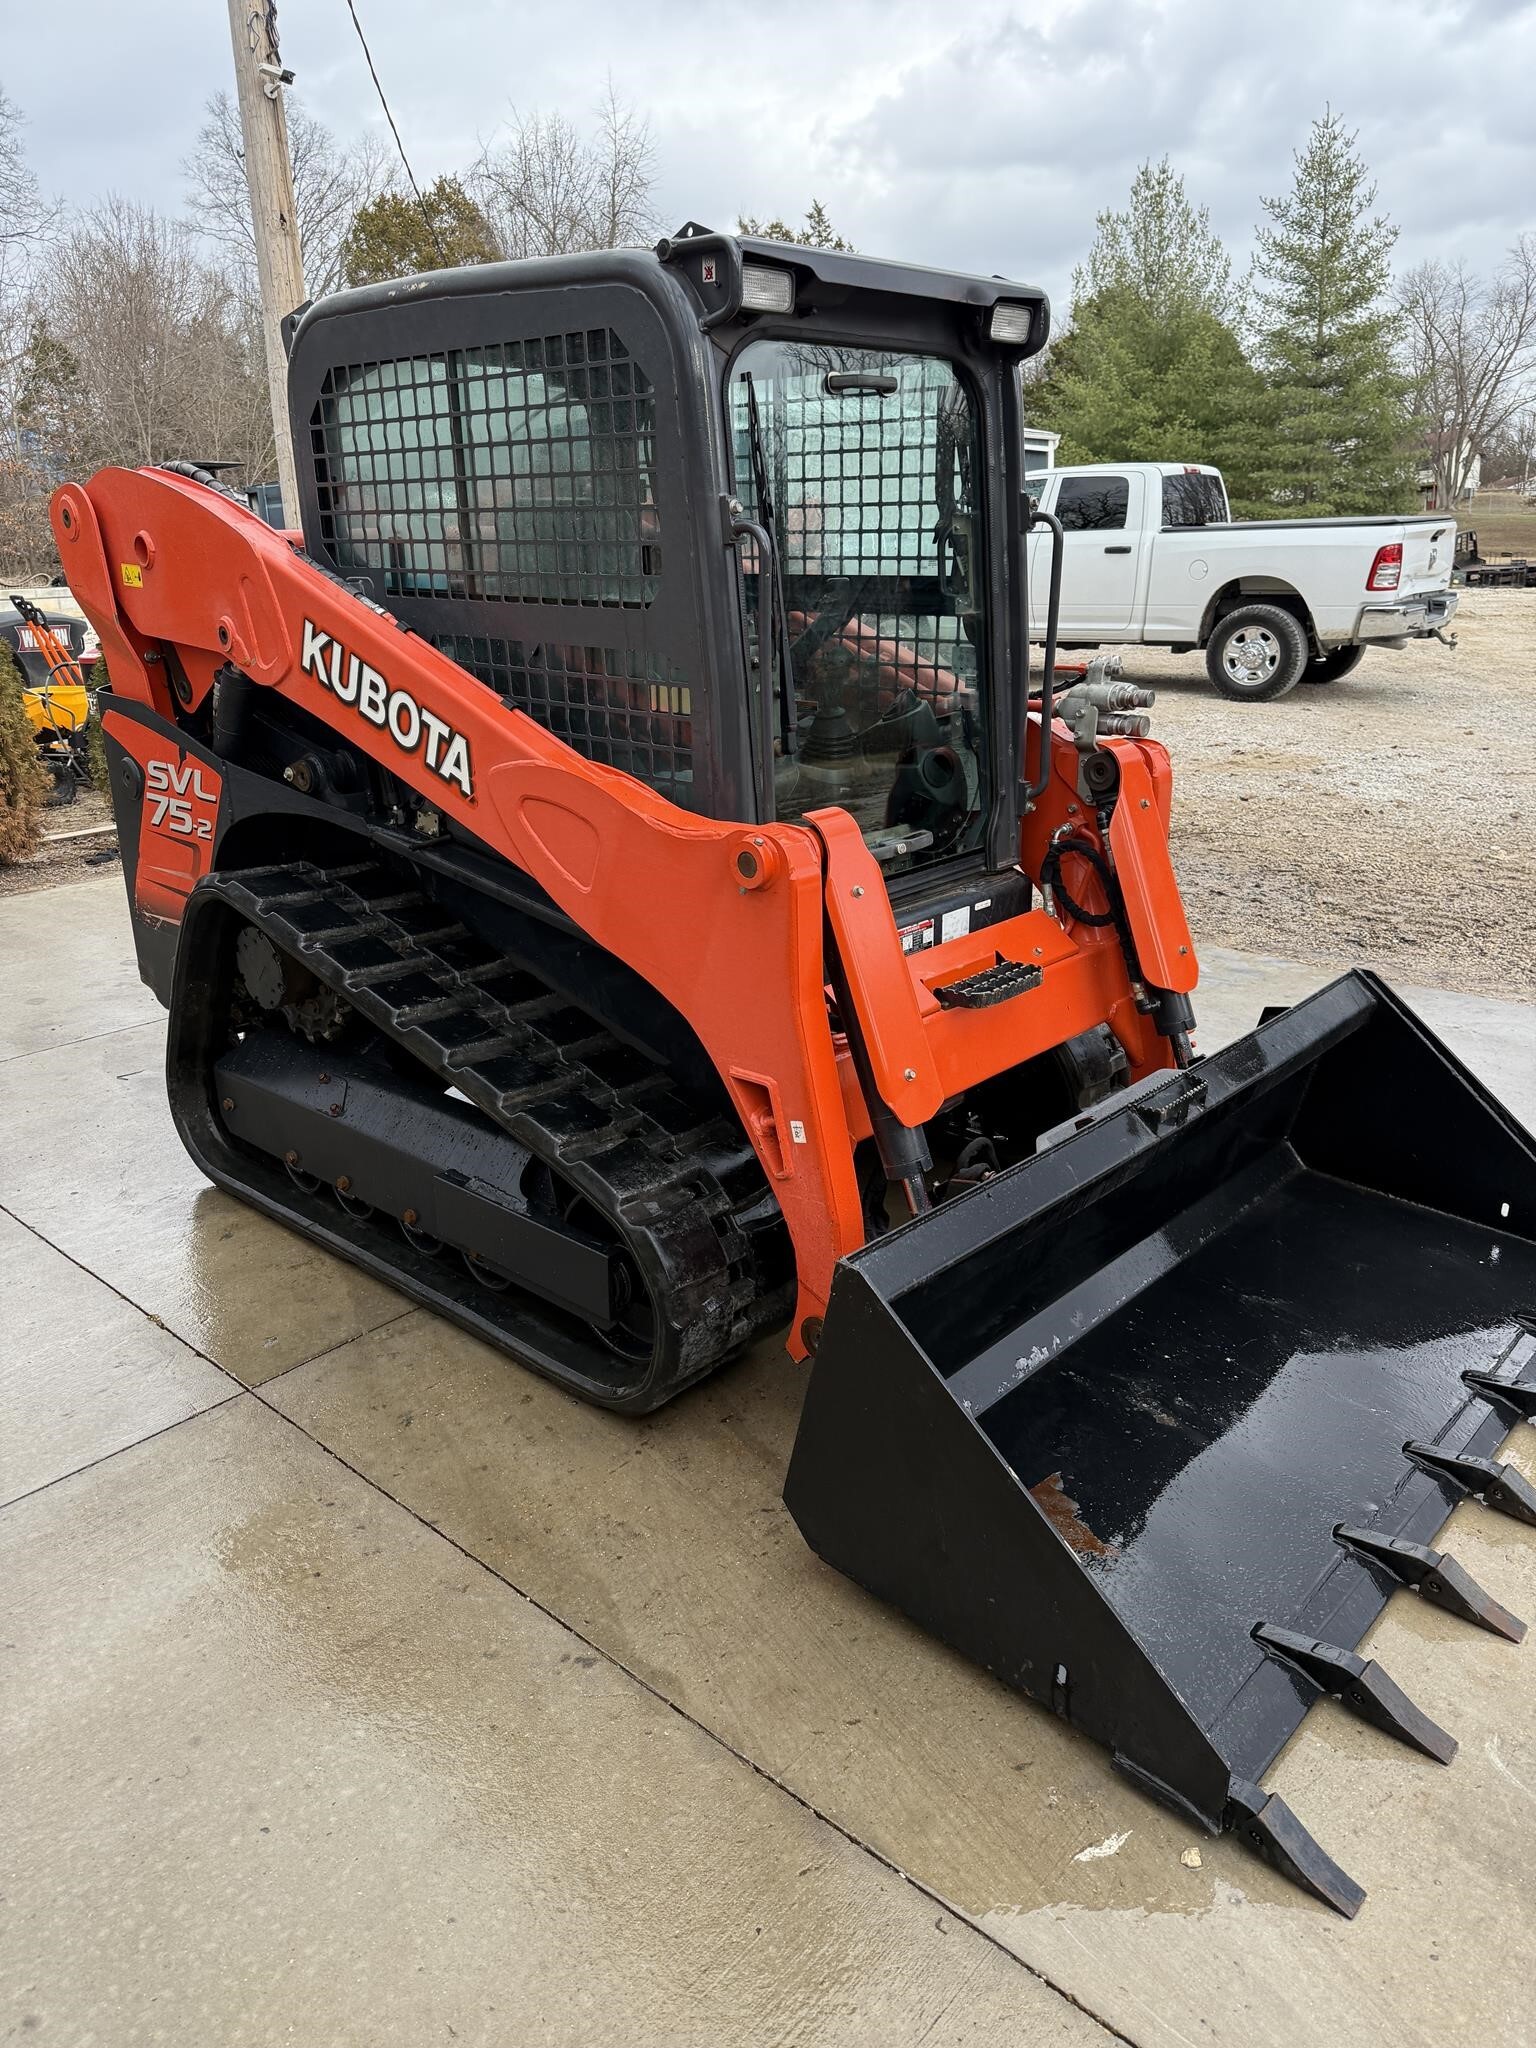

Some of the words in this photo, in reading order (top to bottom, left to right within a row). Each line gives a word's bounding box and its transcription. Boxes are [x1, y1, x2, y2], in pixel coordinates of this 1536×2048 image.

[301, 618, 472, 796] KUBOTA
[147, 760, 217, 804] SVL
[146, 792, 212, 841] 75-2
